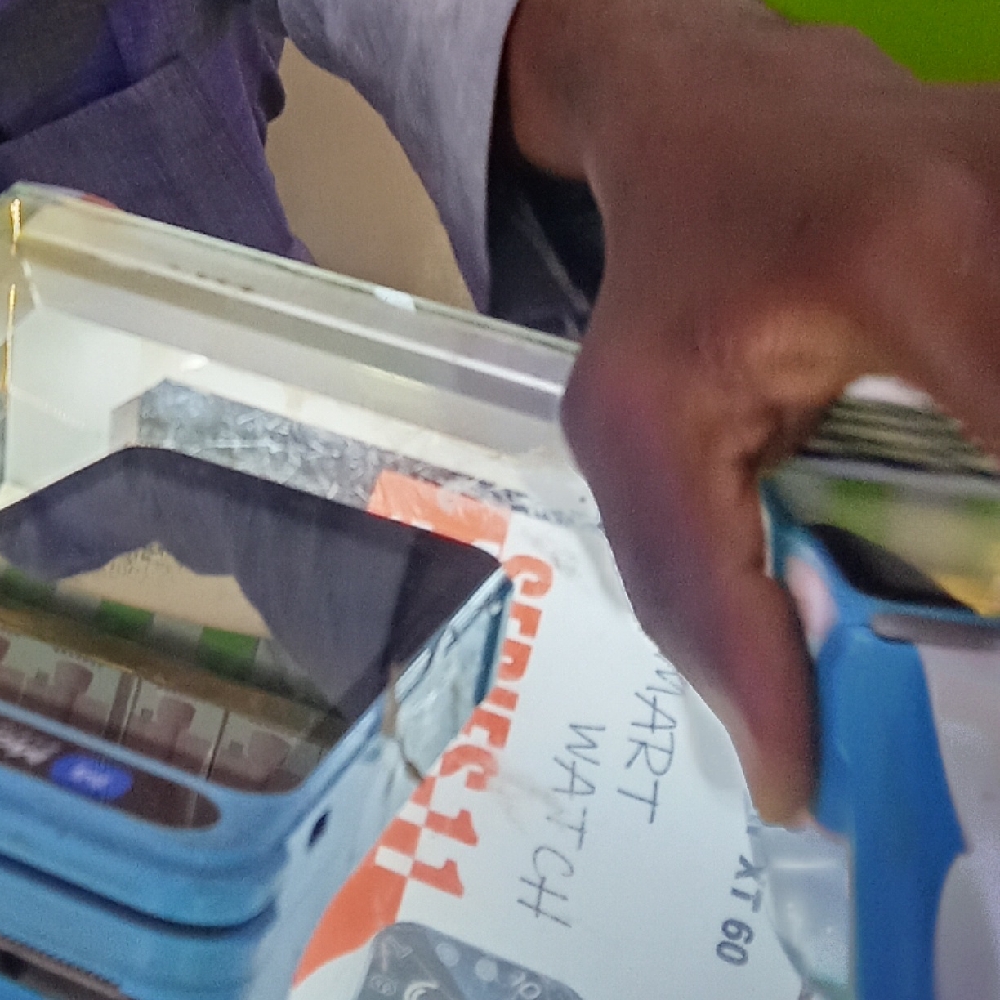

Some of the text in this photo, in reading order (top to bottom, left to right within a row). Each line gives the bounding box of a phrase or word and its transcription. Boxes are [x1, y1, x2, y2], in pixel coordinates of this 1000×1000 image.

[616, 652, 687, 824] MART
[516, 721, 606, 928] WATCH
[716, 918, 755, 967] 60
